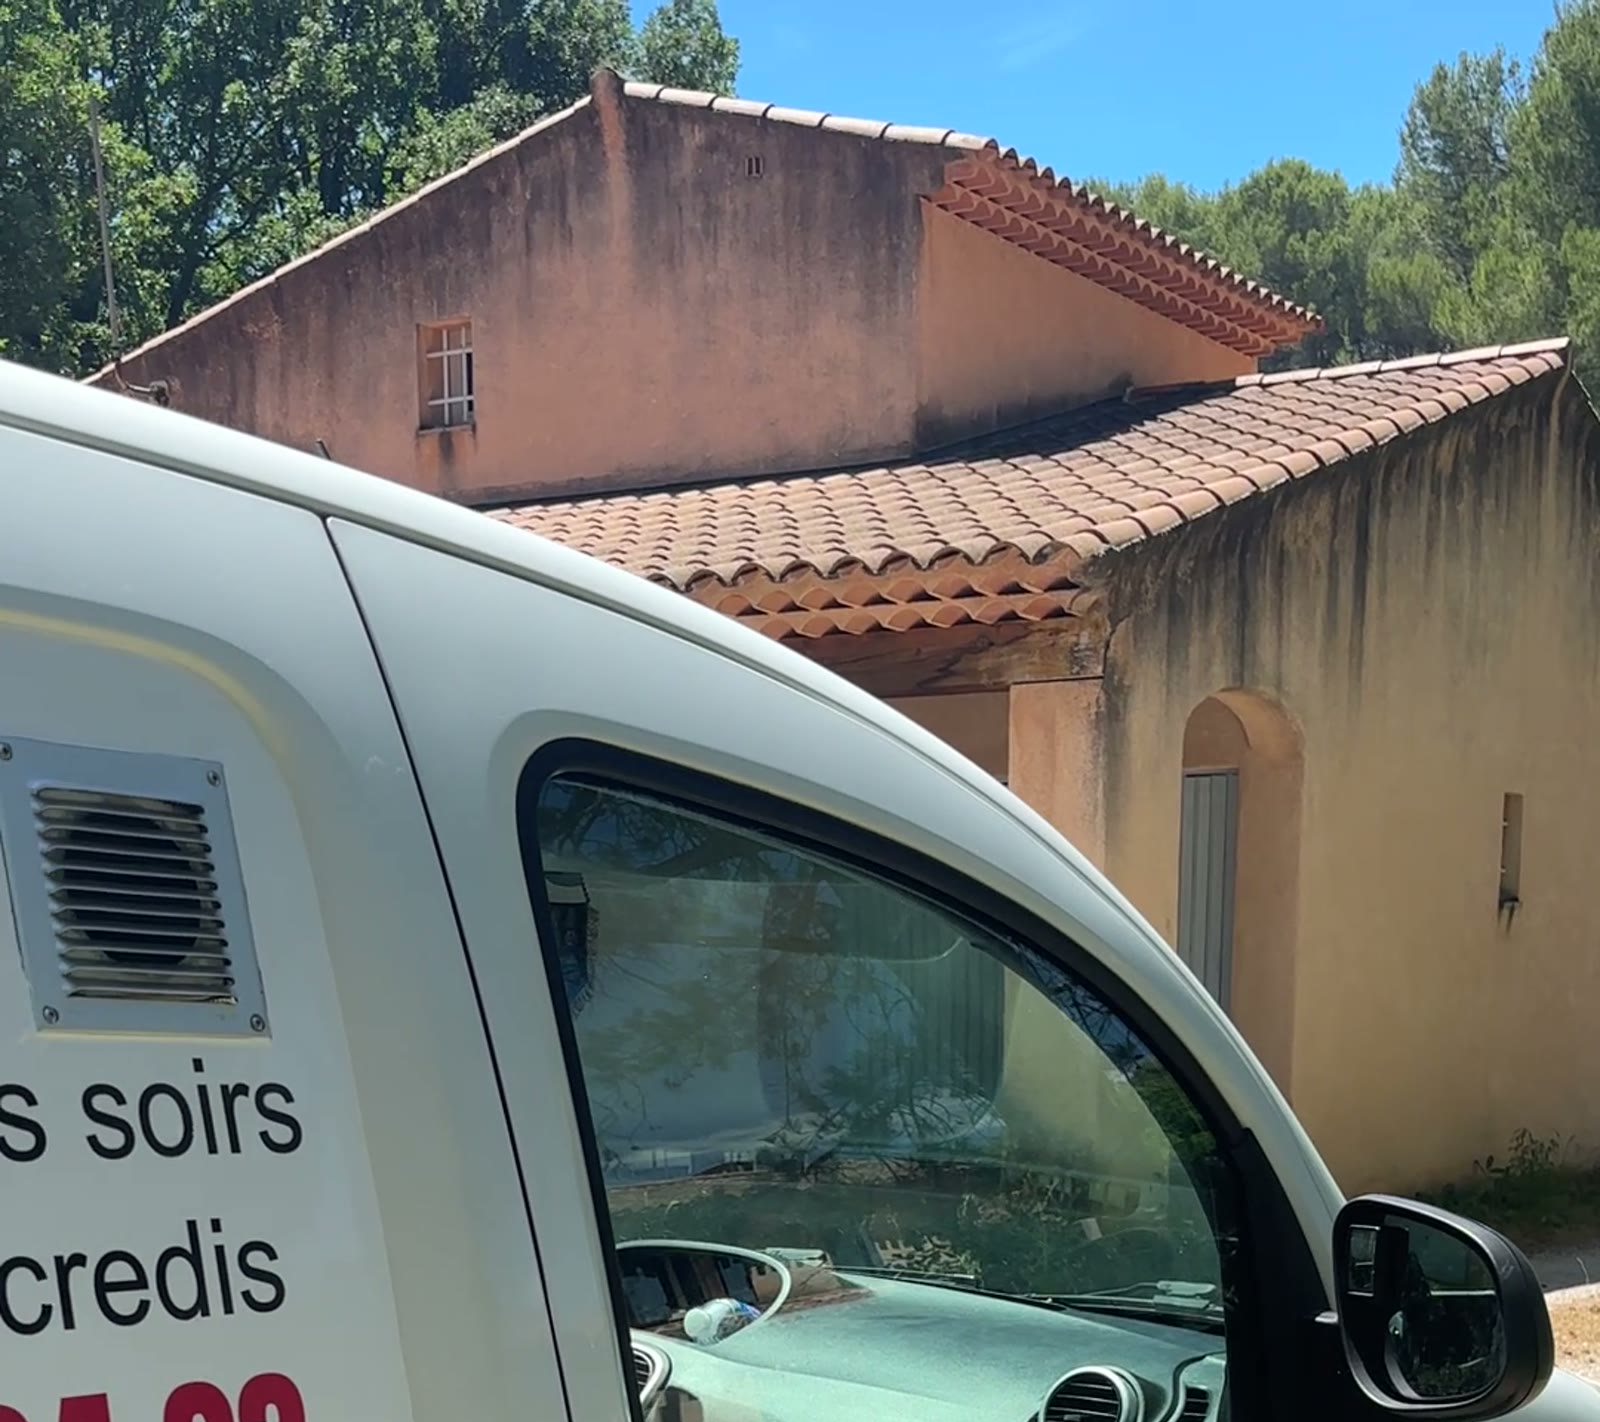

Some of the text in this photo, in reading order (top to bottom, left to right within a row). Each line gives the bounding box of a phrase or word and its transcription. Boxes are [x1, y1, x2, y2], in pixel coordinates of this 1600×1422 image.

[0, 1057, 303, 1162] s soirs
[0, 1217, 286, 1336] credis
